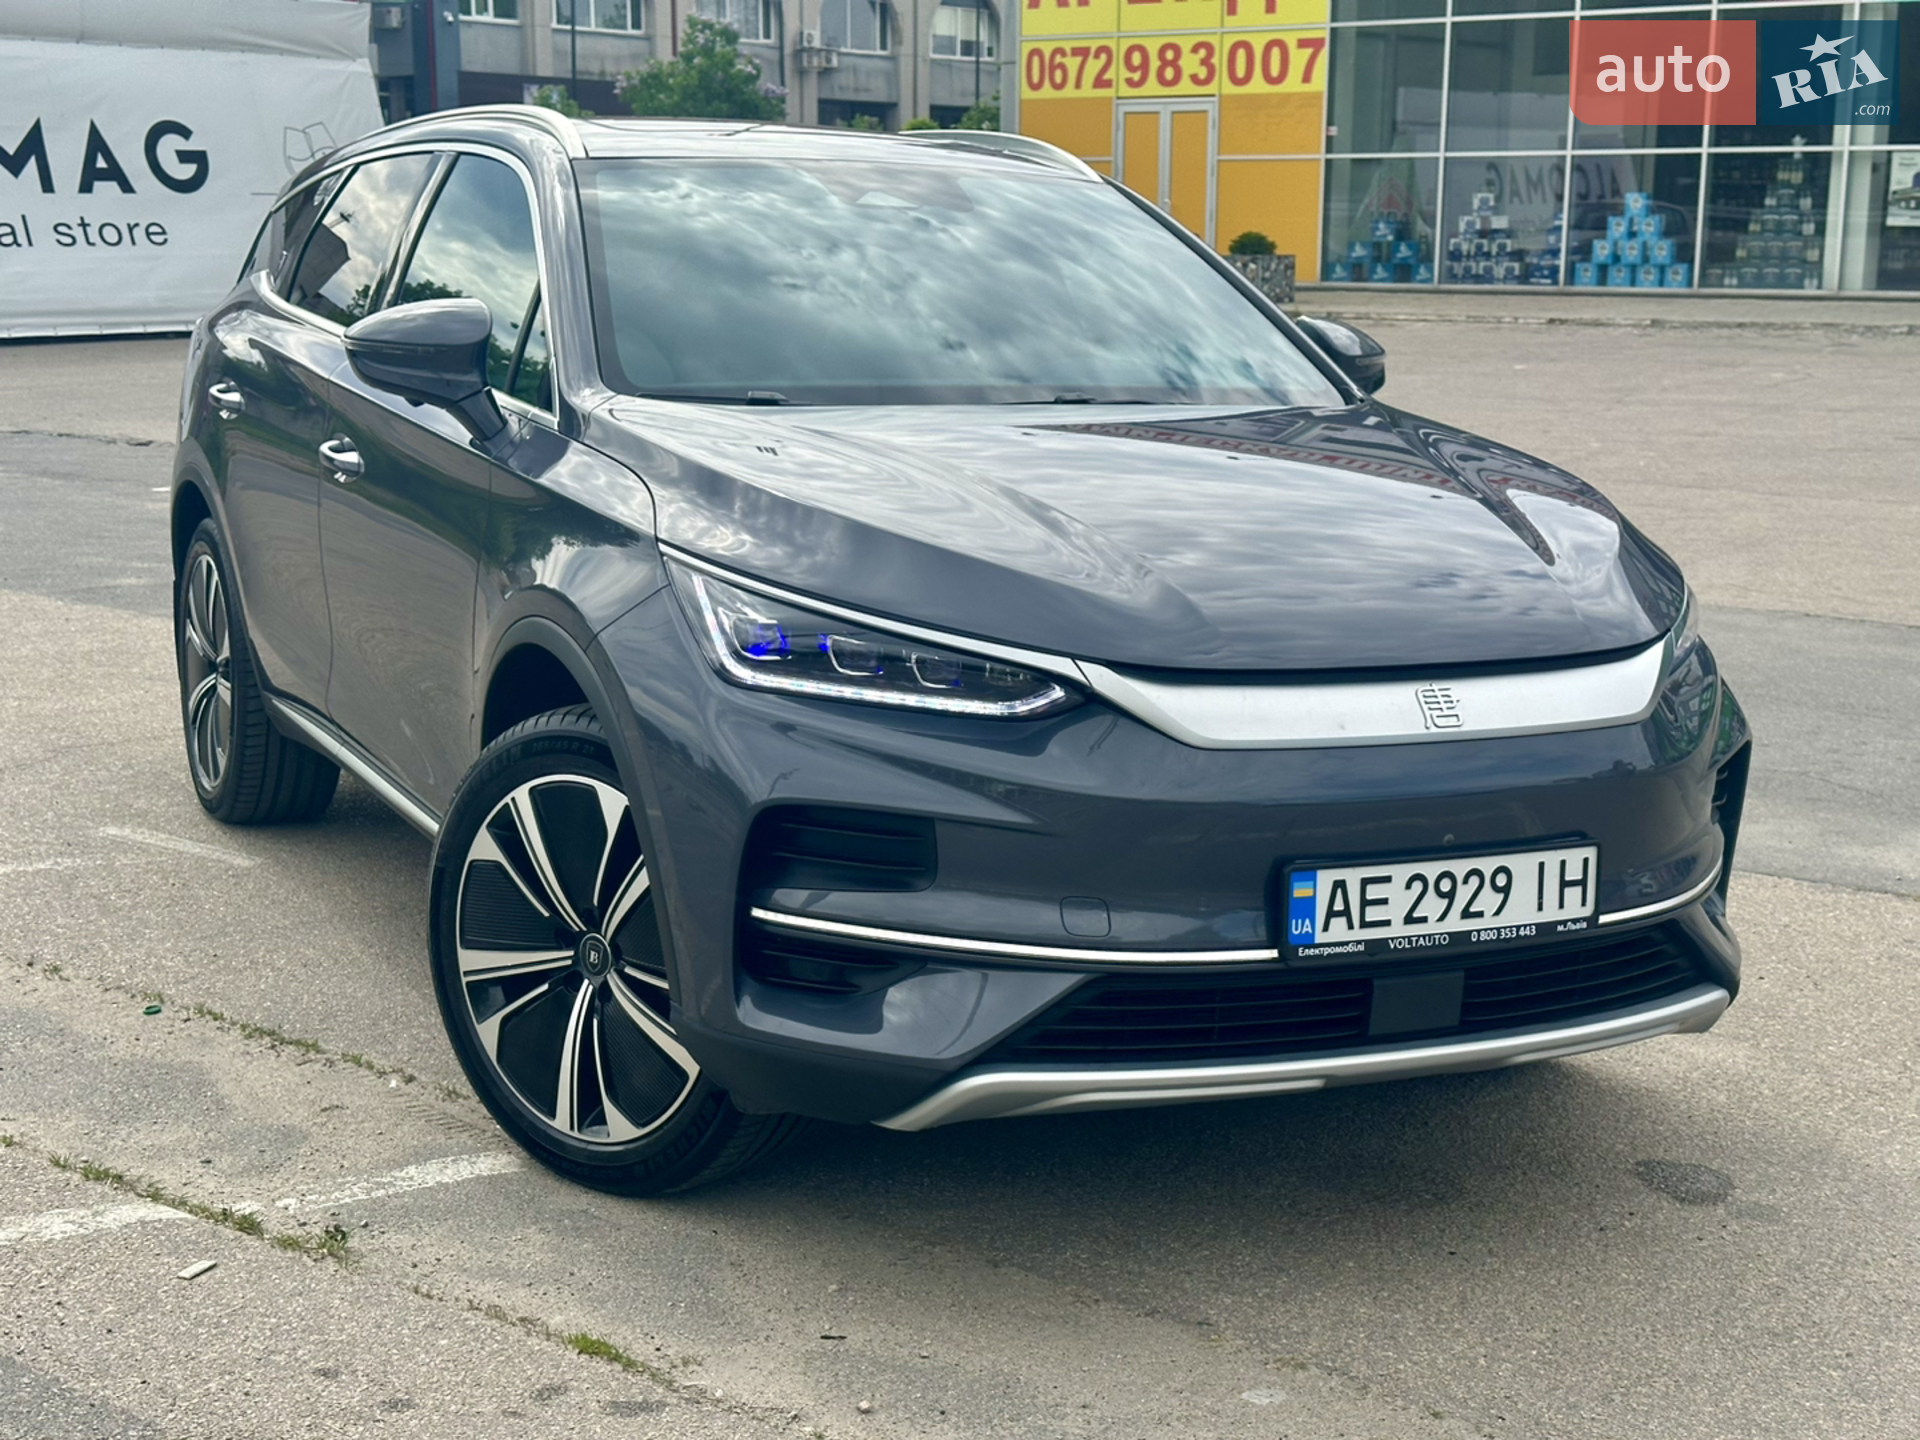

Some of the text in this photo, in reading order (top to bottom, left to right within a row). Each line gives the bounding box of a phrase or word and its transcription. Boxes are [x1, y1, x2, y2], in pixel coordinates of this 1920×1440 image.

[53, 216, 168, 247] store
[571, 742, 579, 752] R
[582, 744, 596, 755] 21
[1403, 865, 1513, 925] 2929
[1537, 856, 1590, 912] IH
[1291, 919, 1313, 934] UA
[1471, 925, 1536, 942] 0 800 353 443
[1388, 934, 1449, 949] VOLTAUTO
[1298, 942, 1365, 957] Електромобілі
